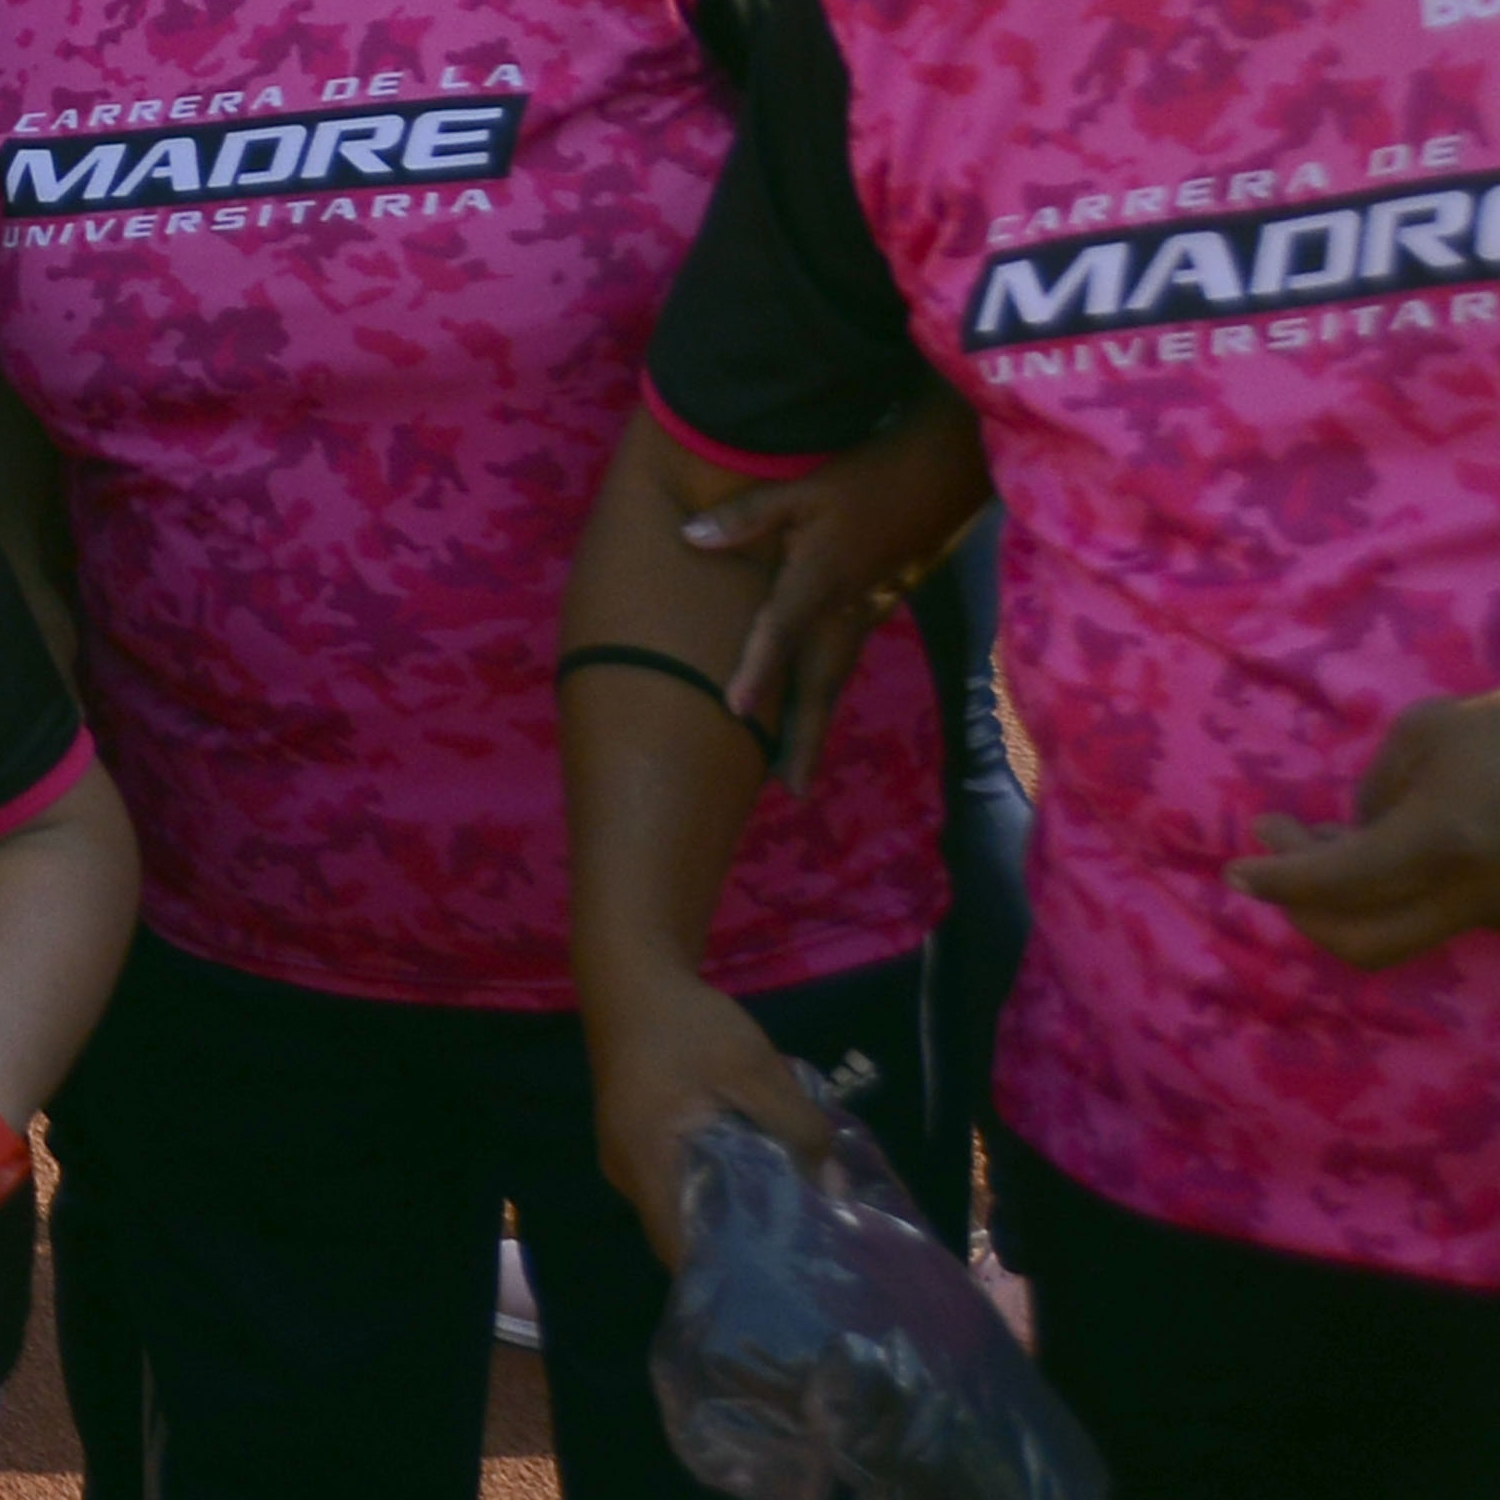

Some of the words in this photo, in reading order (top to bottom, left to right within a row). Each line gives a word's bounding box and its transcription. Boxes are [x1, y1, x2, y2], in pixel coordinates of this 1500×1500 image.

[12, 83, 285, 133] CARRERA
[320, 71, 404, 104] DE
[440, 62, 527, 91] LA
[5, 107, 505, 207] MADRE
[988, 161, 1329, 246] CARRERA
[1365, 134, 1466, 180] DE
[2, 187, 494, 249] UNIVERSITARIA
[980, 290, 1498, 386] UNIVERSITAR
